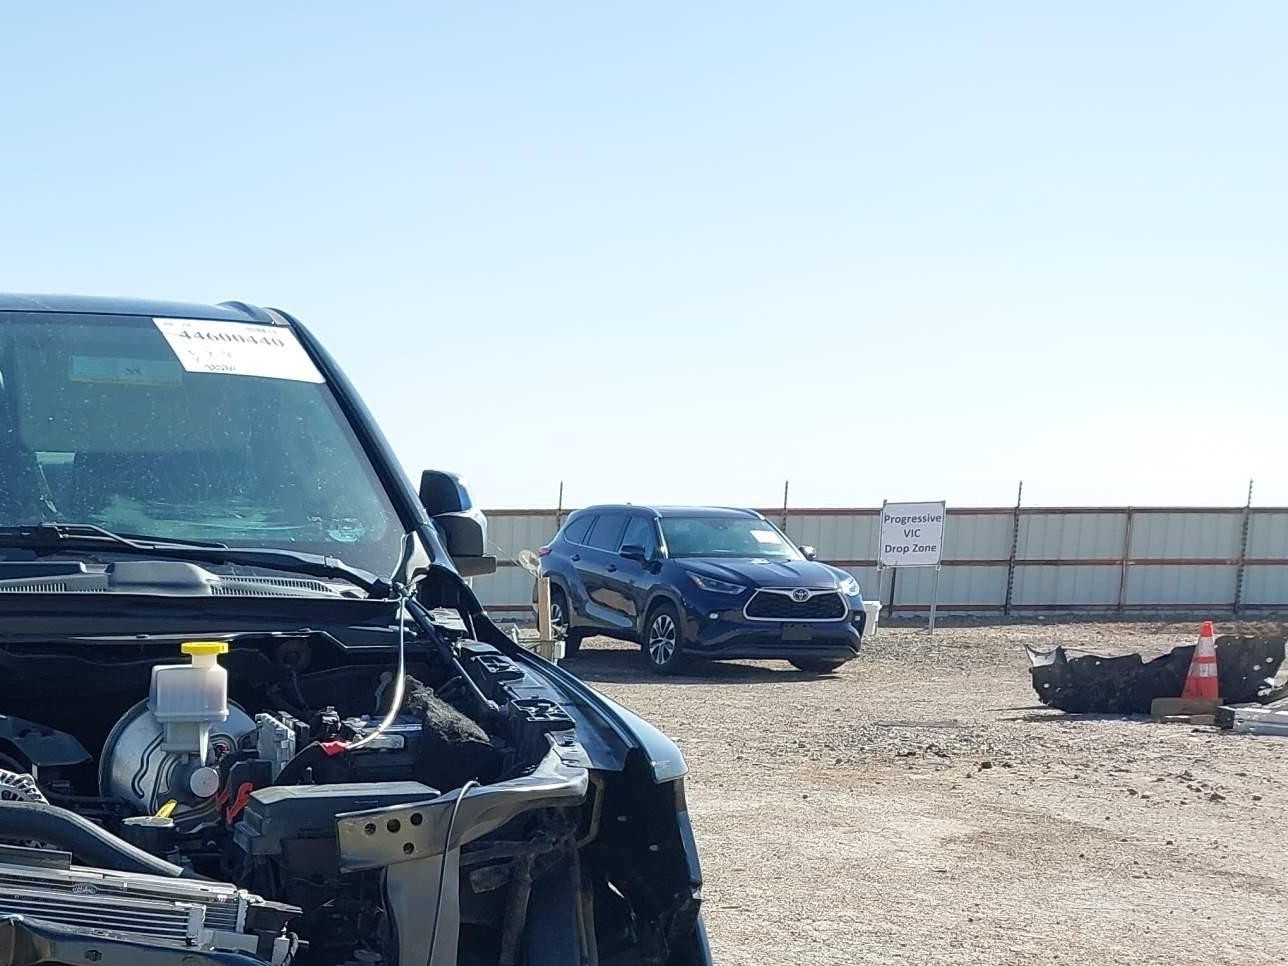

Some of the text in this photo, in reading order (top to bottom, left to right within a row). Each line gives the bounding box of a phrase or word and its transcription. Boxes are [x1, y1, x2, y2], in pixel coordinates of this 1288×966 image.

[179, 330, 285, 347] 44600440
[883, 513, 942, 525] Progressive
[903, 529, 921, 538] VIC
[884, 544, 937, 554] Drop Zone
